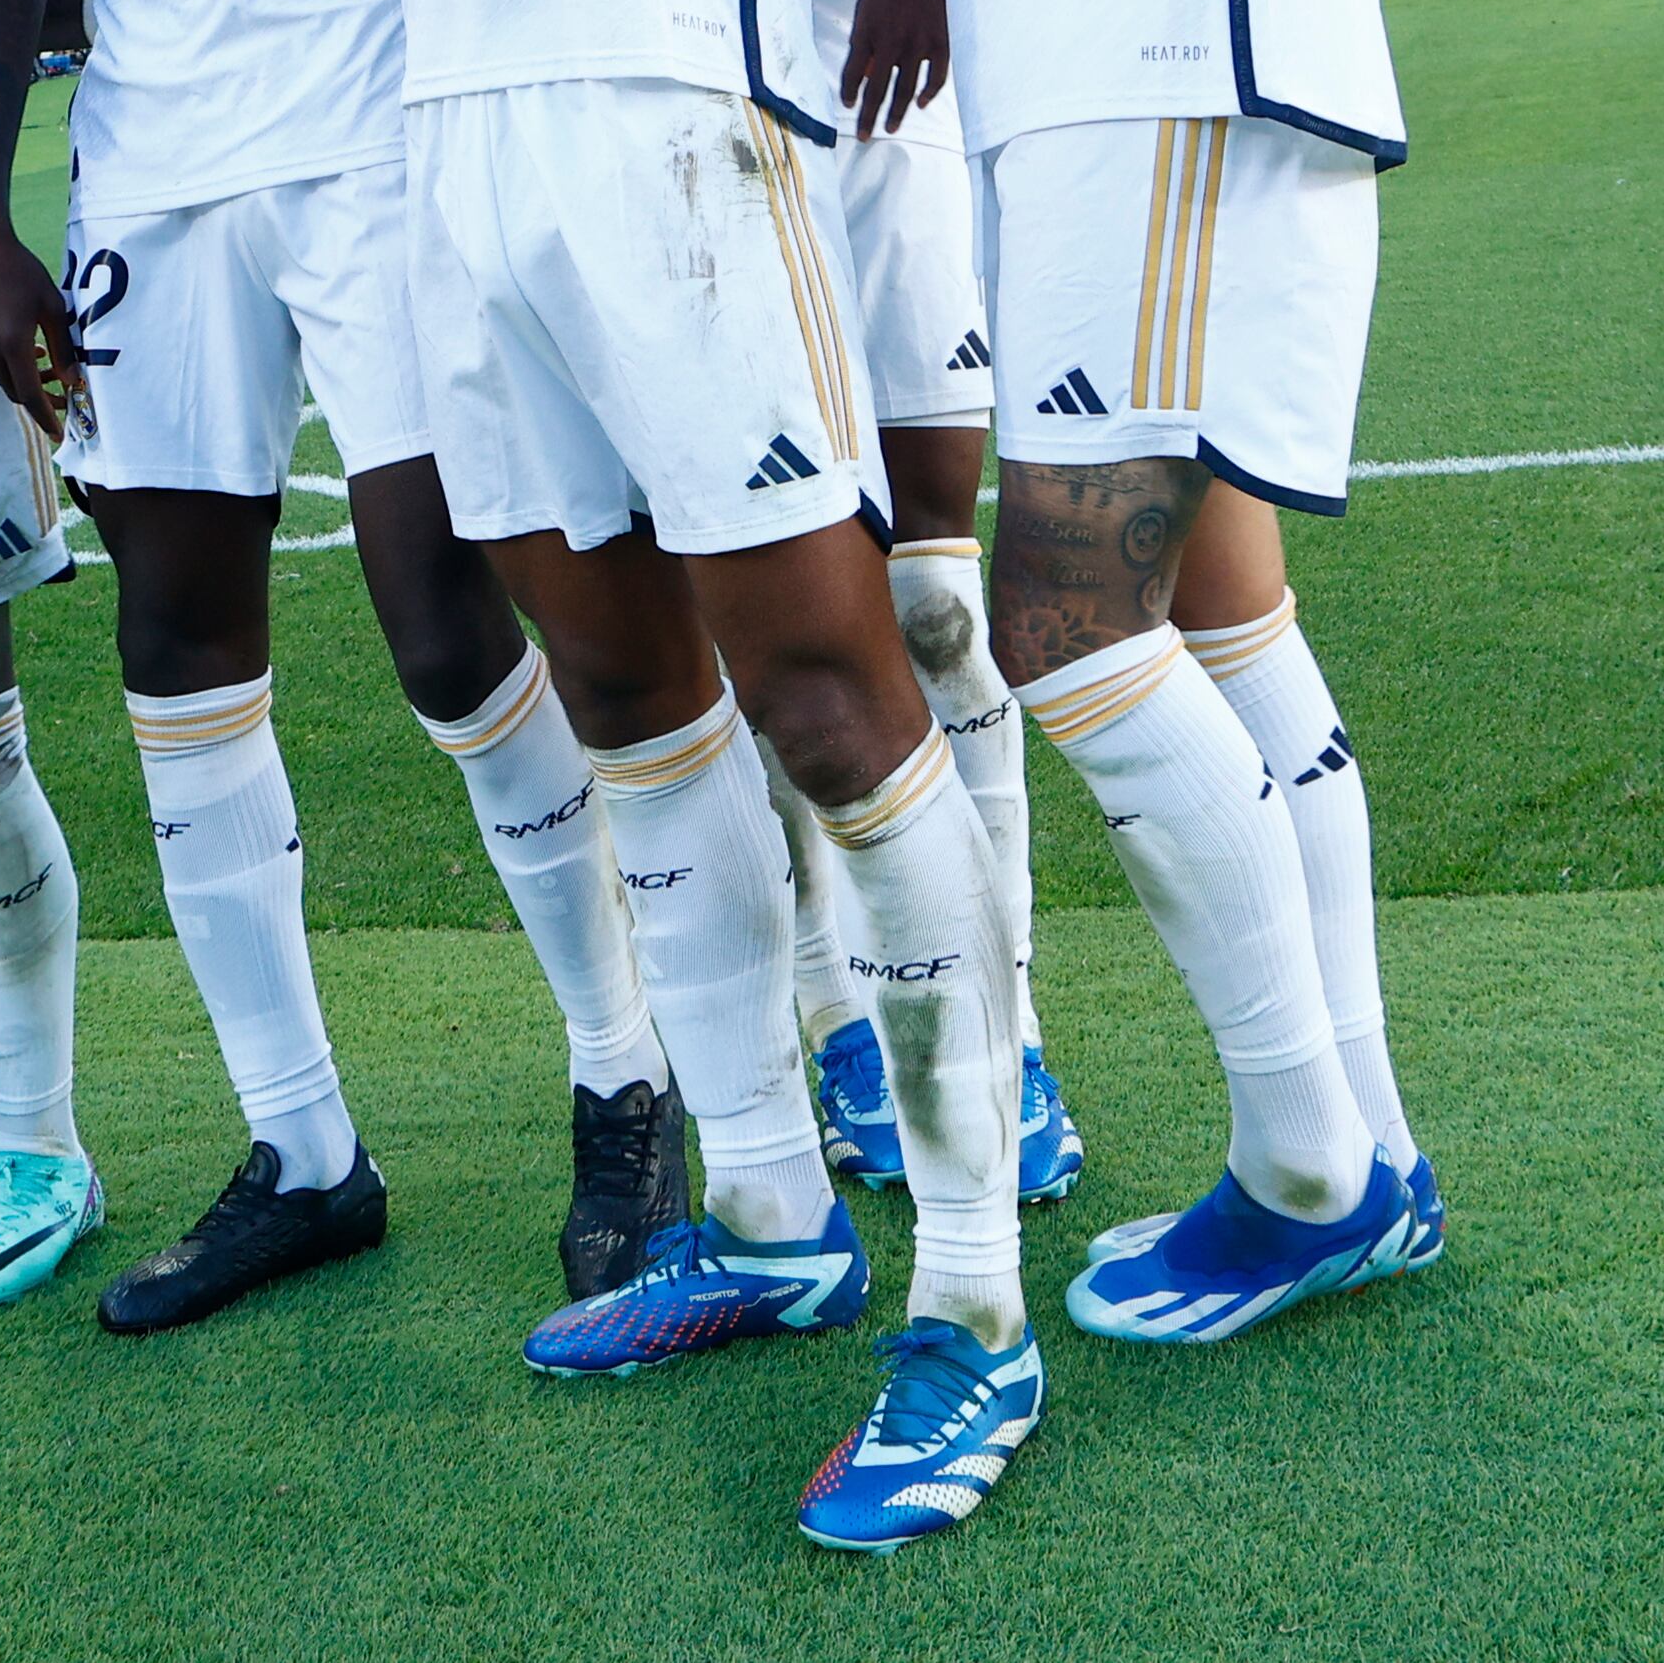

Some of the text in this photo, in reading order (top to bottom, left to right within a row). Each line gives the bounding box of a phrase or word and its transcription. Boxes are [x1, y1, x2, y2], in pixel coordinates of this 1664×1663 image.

[943, 697, 1013, 736] MCF
[494, 776, 594, 839] RMCF
[152, 821, 191, 840] CF
[618, 868, 693, 890] MCF
[849, 955, 961, 982] RMCF
[688, 1288, 741, 1303] PREDATOR
